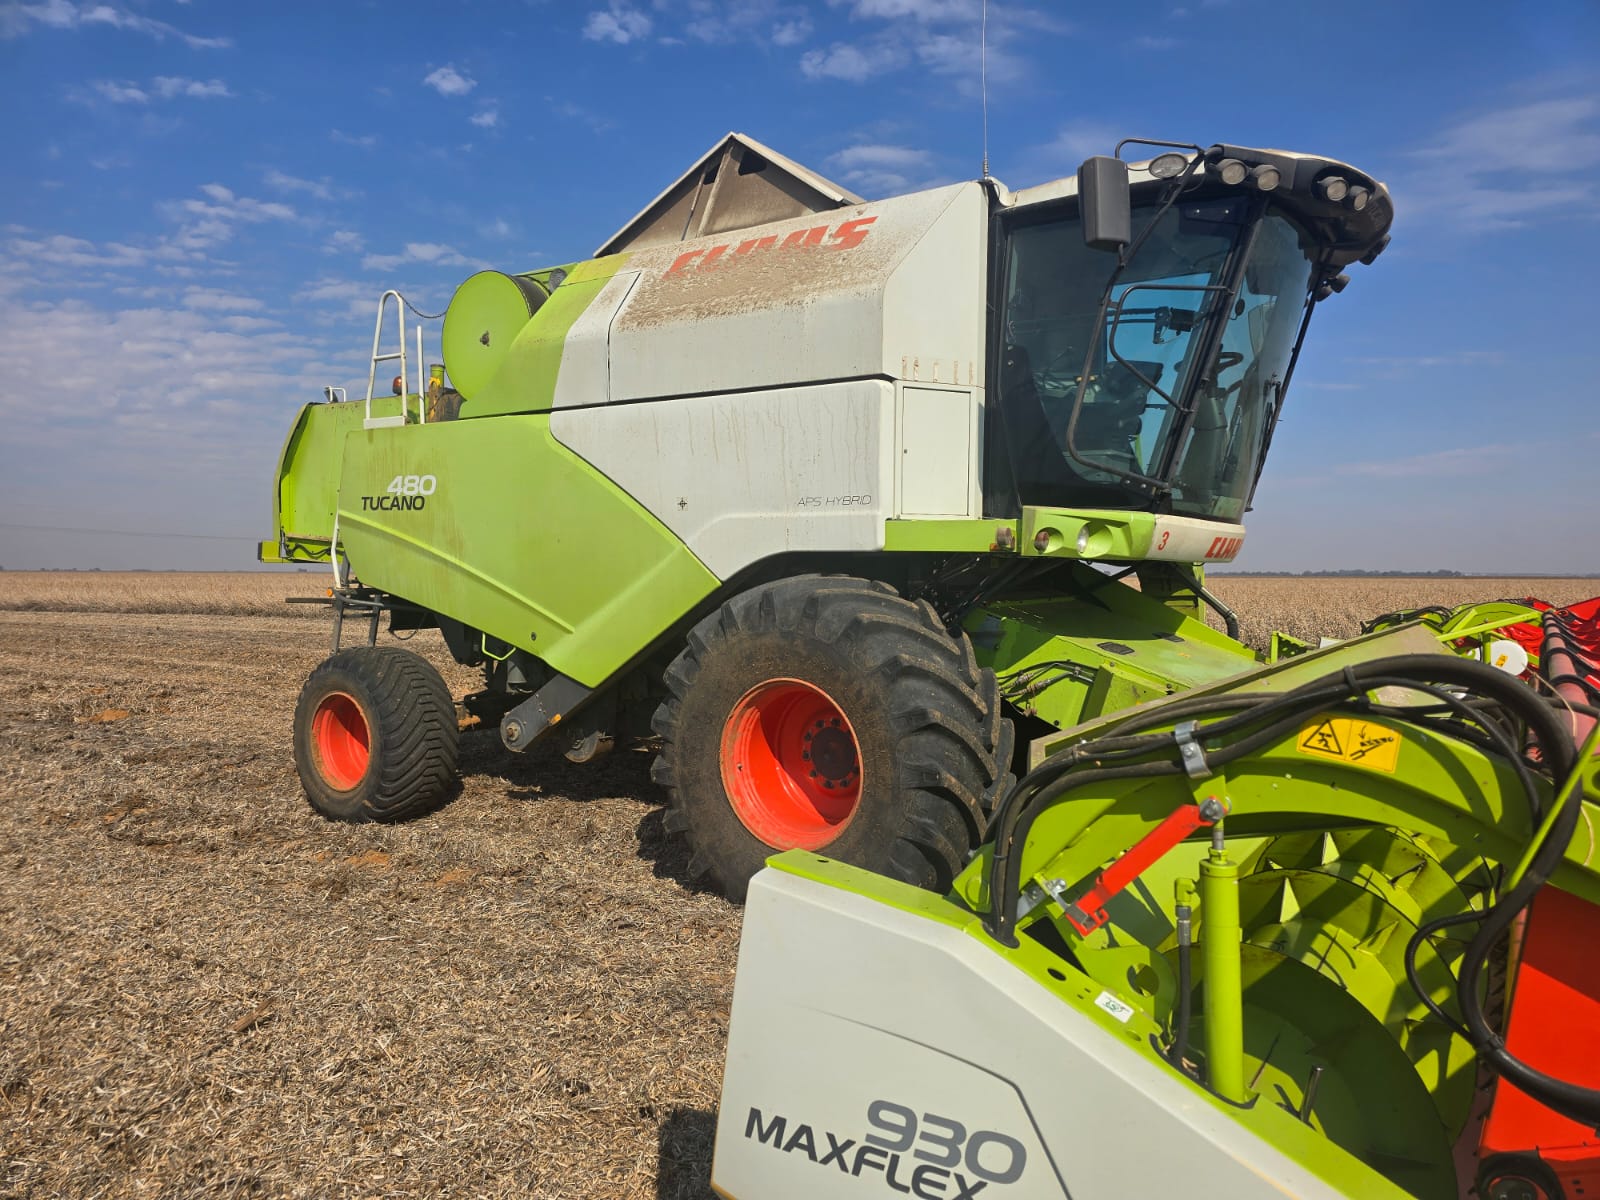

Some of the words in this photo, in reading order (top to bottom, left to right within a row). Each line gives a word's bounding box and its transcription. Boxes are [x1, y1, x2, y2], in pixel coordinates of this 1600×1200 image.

[387, 474, 437, 496] 480
[361, 495, 426, 511] TUCANO
[797, 496, 822, 507] APS
[826, 494, 872, 506] HYBRID
[1158, 531, 1170, 551] 3
[865, 1099, 1027, 1185] 930
[744, 1106, 988, 1200] MAXFLEX
